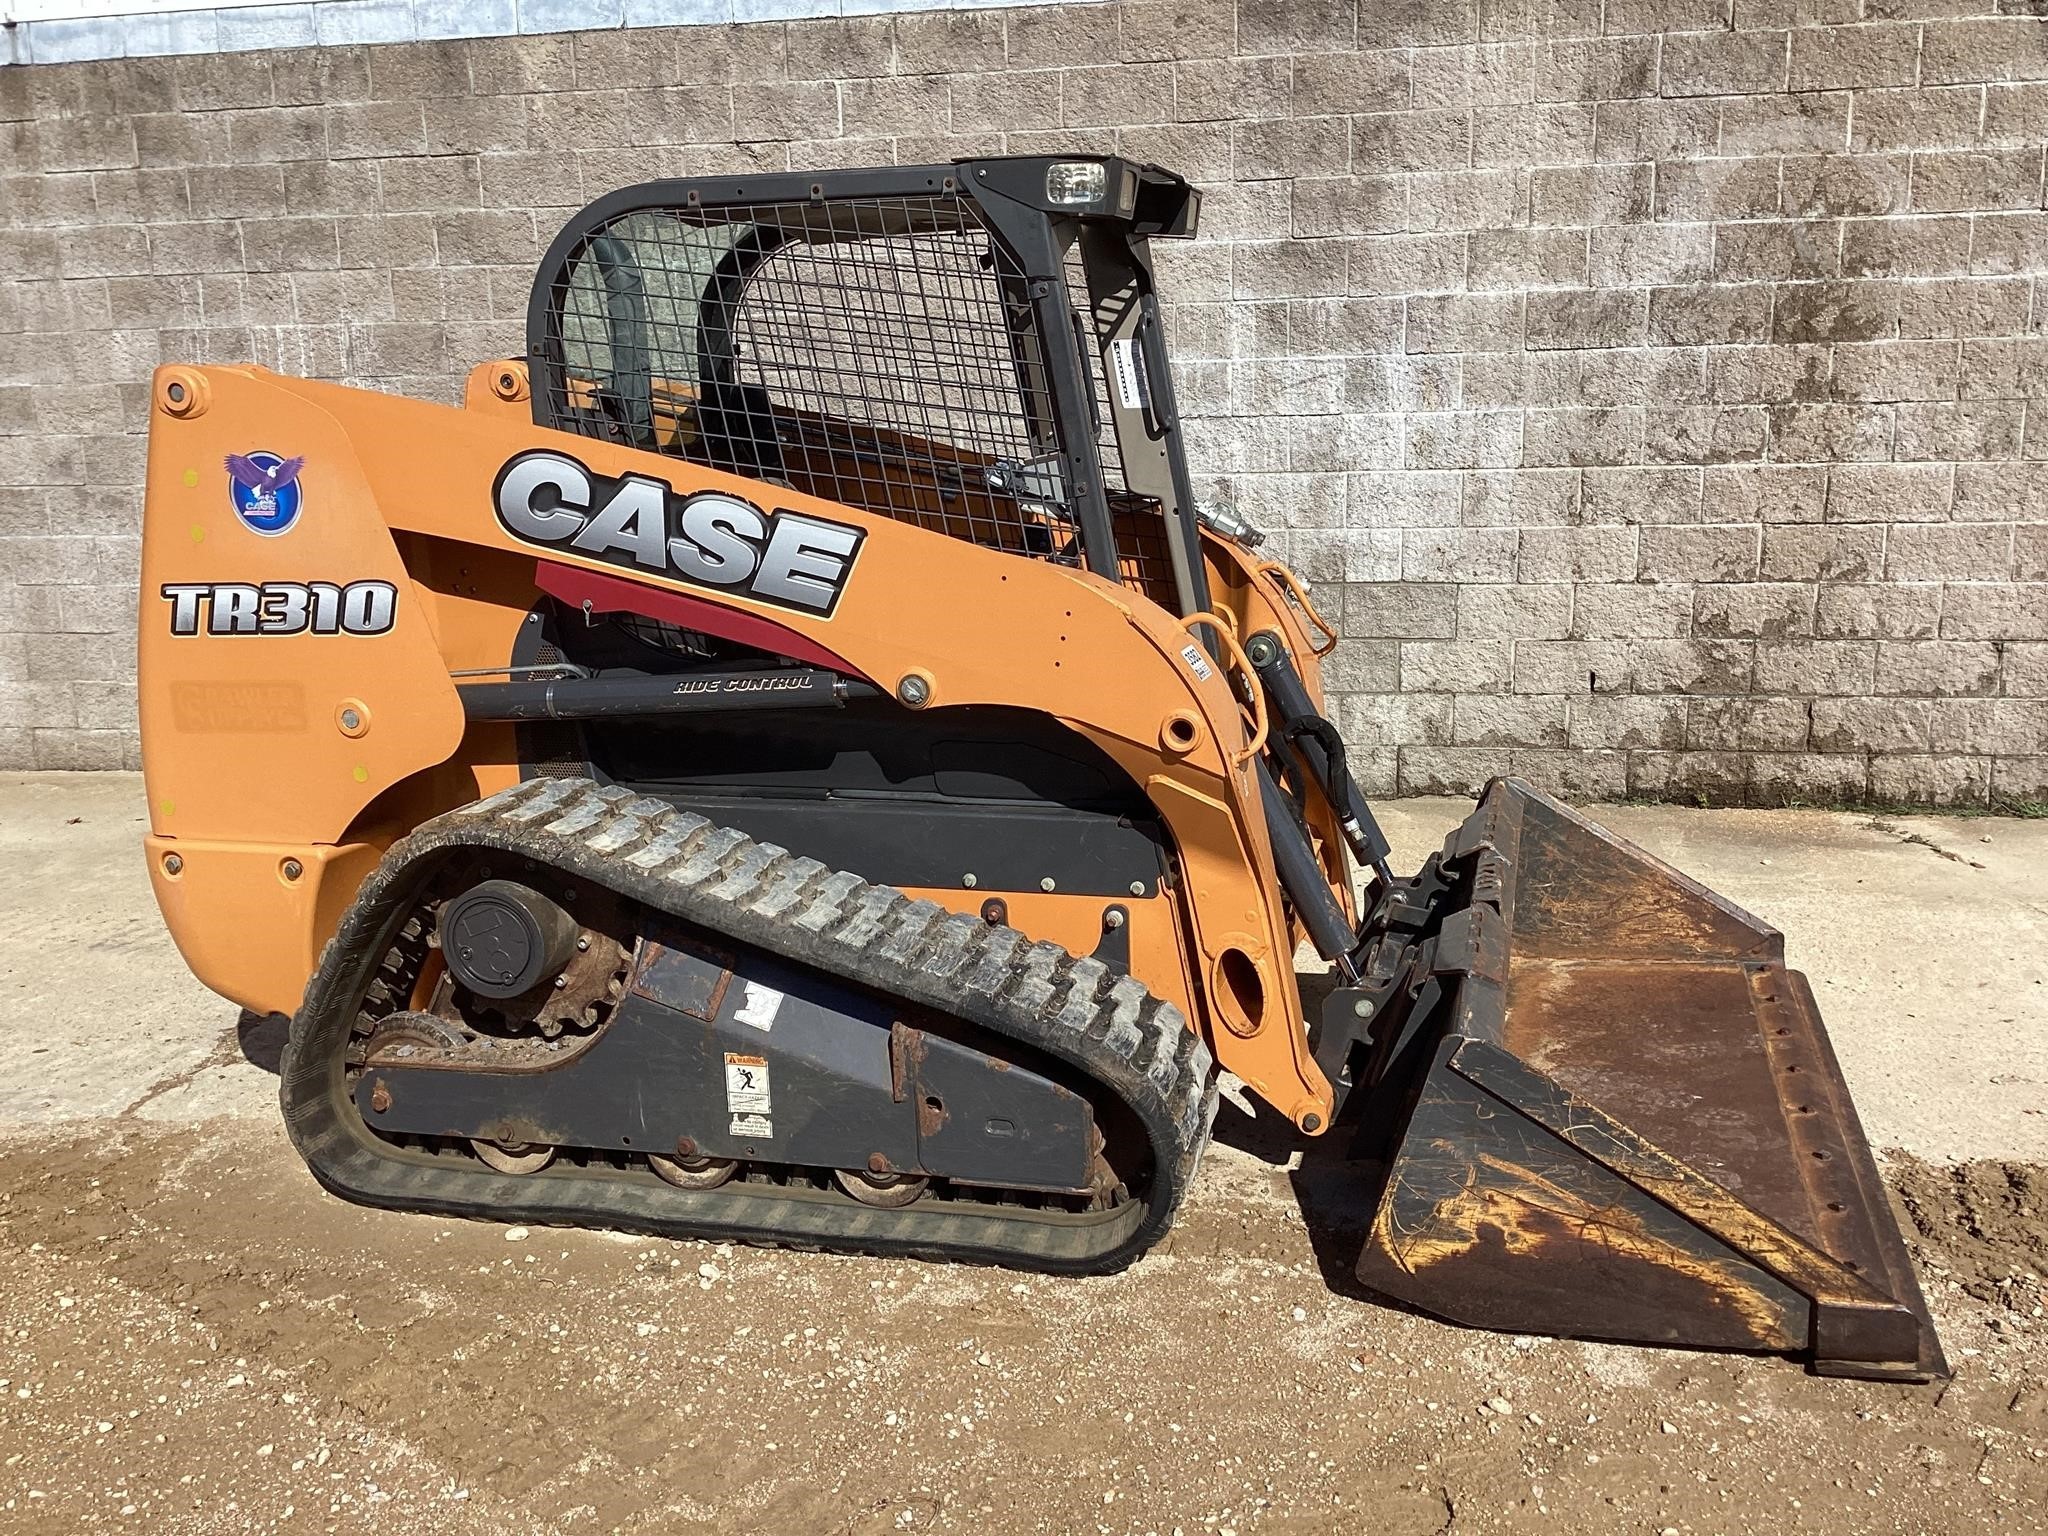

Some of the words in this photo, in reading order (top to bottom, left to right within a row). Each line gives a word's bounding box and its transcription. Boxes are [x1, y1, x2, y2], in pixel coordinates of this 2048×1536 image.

[497, 453, 862, 612] CASE
[162, 582, 397, 635] TR310
[673, 680, 721, 694] RIDE
[723, 676, 813, 692] CONTROL
